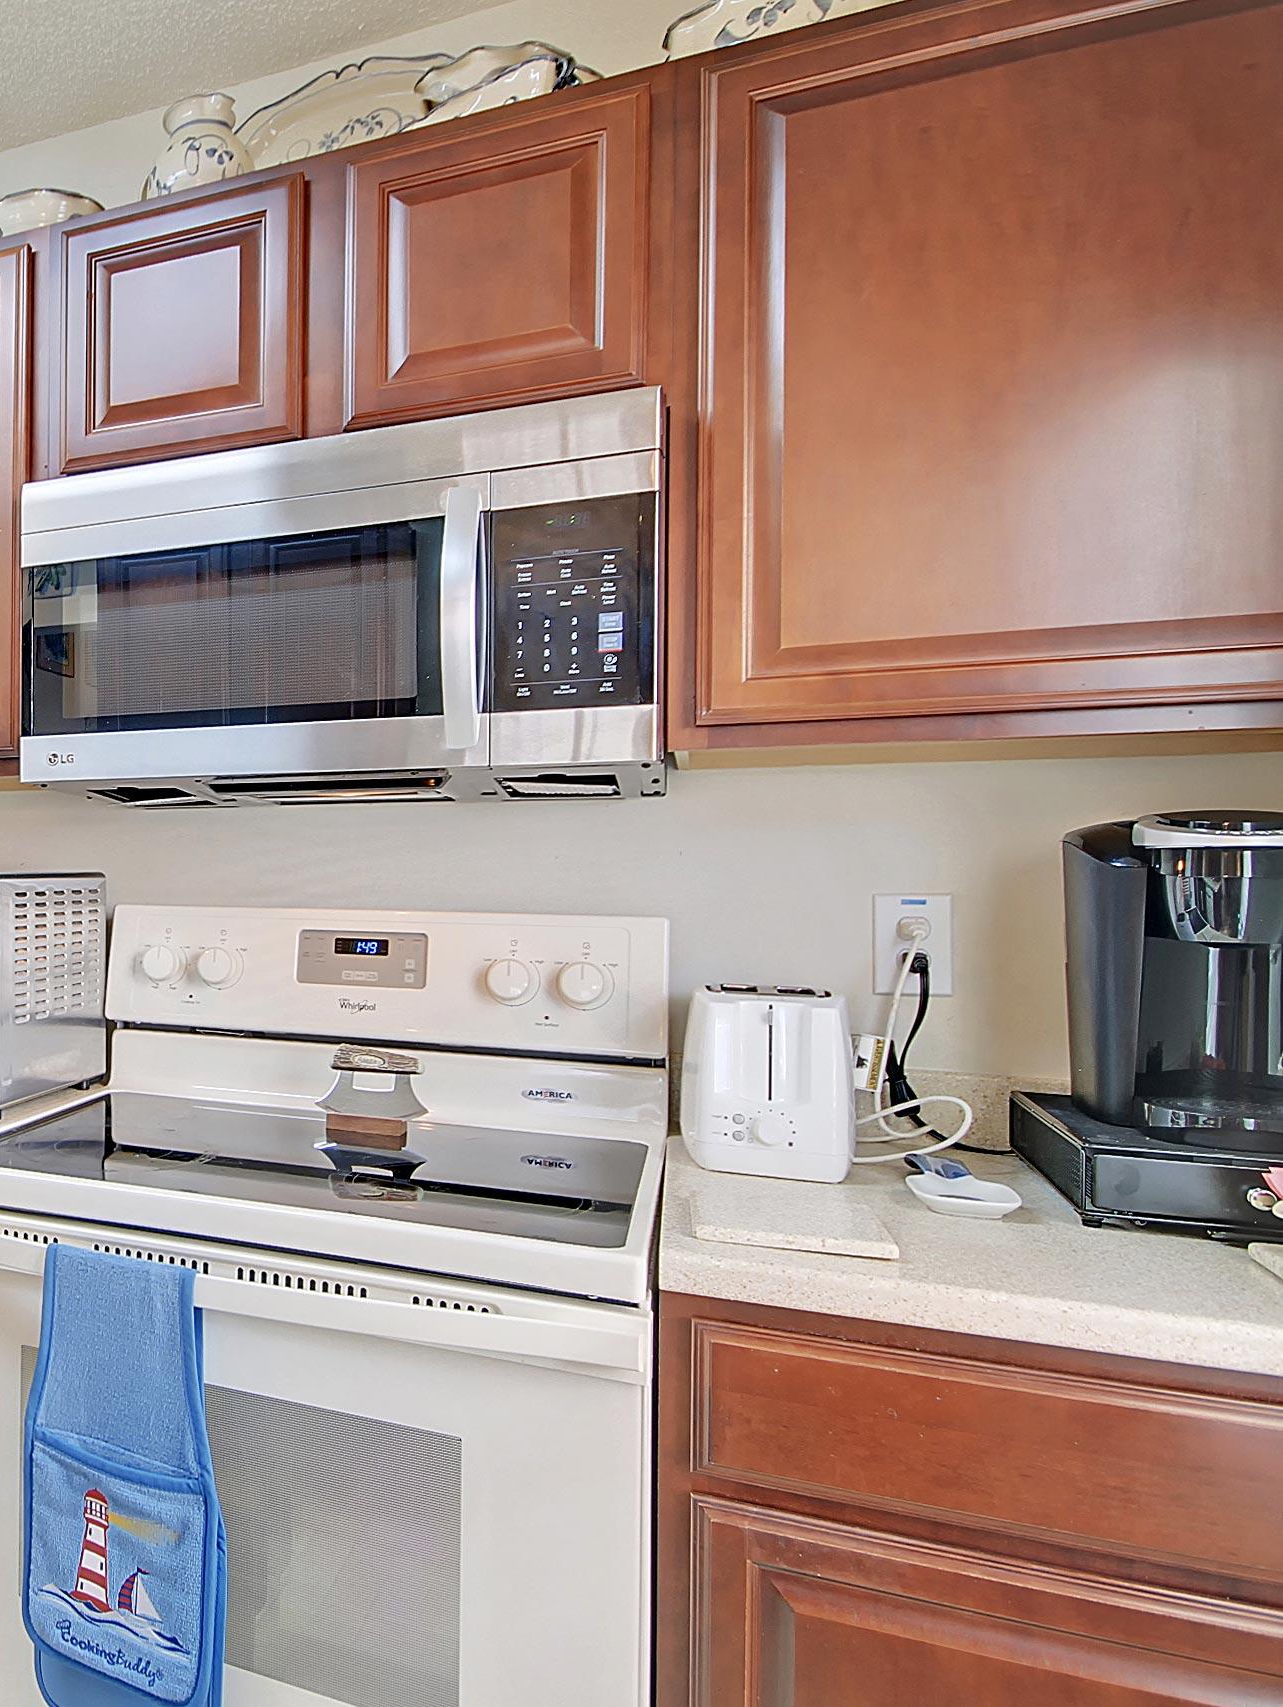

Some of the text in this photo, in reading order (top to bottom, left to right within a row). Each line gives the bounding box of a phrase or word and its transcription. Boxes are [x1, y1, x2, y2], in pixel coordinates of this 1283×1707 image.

[517, 621, 523, 630] 1
[543, 619, 550, 628] 2
[571, 616, 578, 626] 3
[516, 636, 523, 644] 4
[544, 633, 550, 642] 5
[571, 631, 578, 641] 6
[516, 650, 523, 659] 7
[543, 648, 550, 657] 8
[571, 646, 578, 655] 9
[543, 663, 550, 672] 0
[60, 753, 75, 764] LG
[356, 941, 378, 954] 1:49
[339, 1001, 377, 1013] Whirlpool
[527, 1089, 573, 1099] AMERICA
